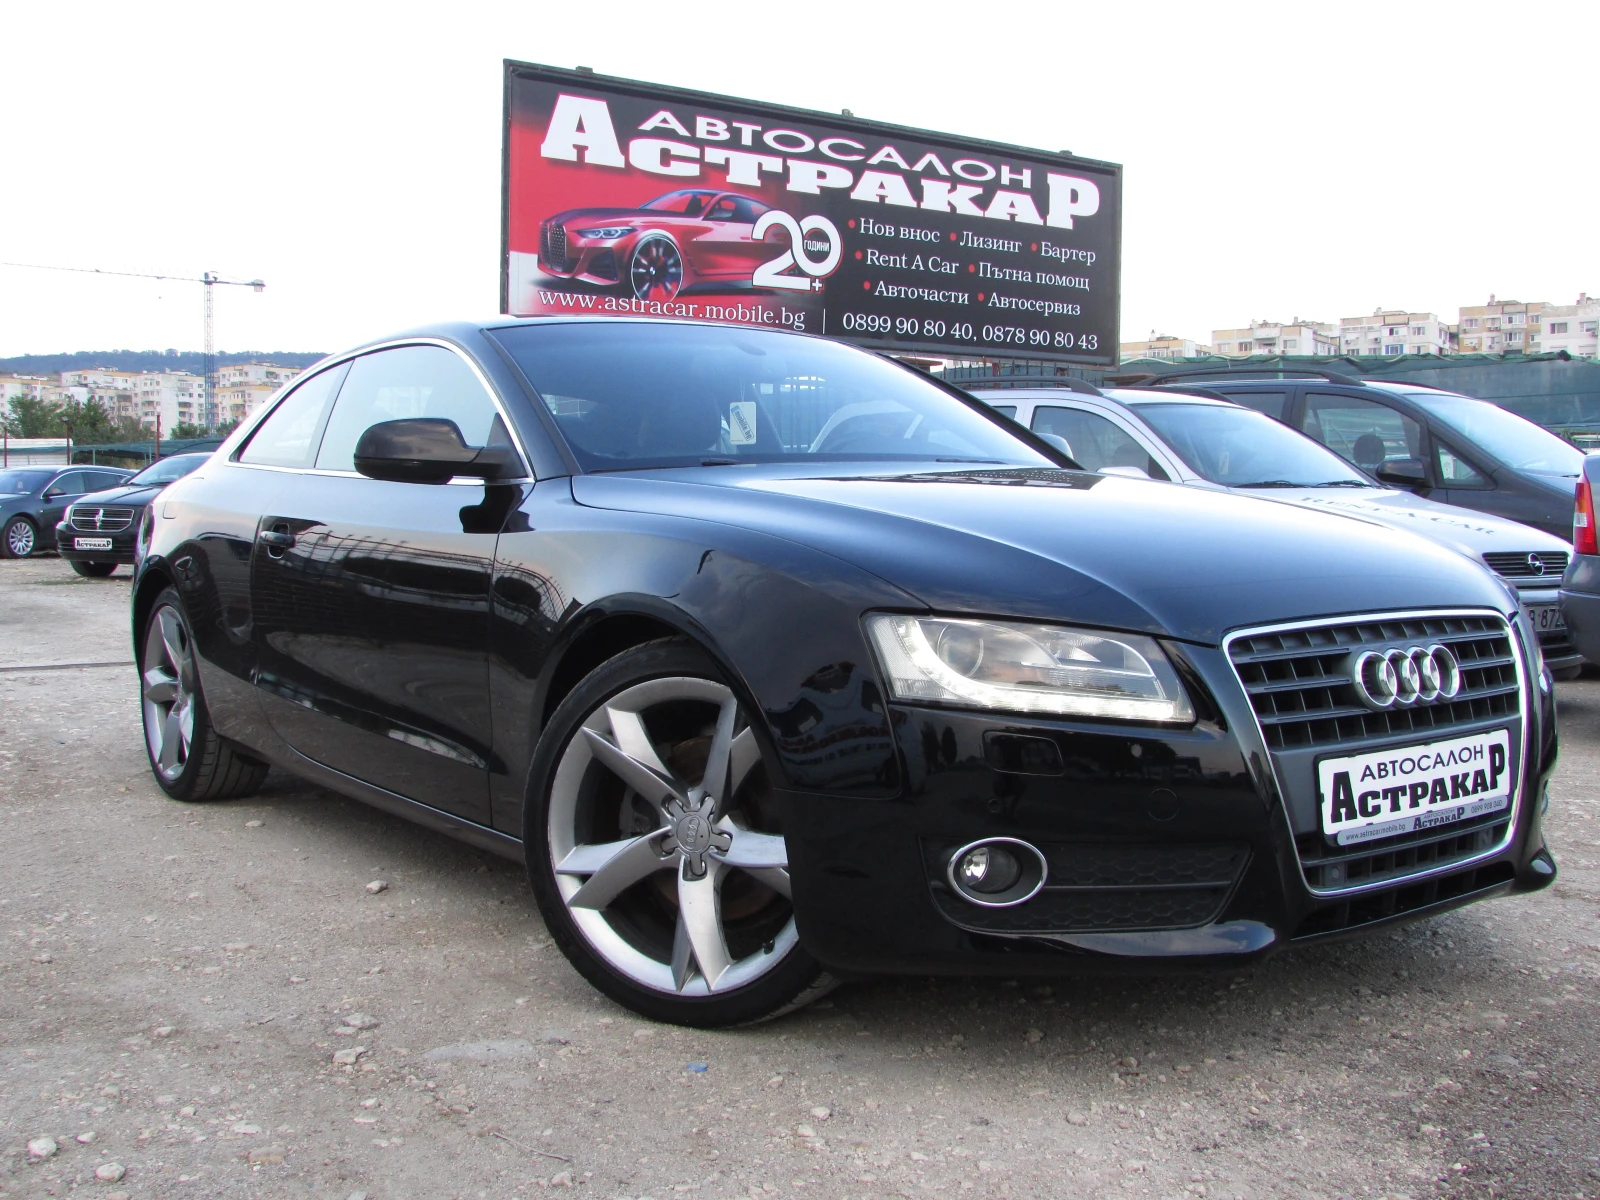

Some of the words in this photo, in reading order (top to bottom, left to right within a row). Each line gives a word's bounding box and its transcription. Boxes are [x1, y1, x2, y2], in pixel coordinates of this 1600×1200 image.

[637, 110, 1032, 188] АВТОСАЛОН
[860, 218, 895, 237] Нов
[900, 226, 940, 243] внос
[960, 232, 1022, 253] Лизинг
[866, 249, 908, 269] Rent
[911, 255, 925, 270] A
[928, 257, 959, 274] Car
[1041, 242, 1096, 266] Бартер
[979, 263, 1032, 283] Пътна
[1036, 273, 1089, 291] помощ
[874, 281, 969, 305] Авточасти
[988, 293, 1081, 316] Автосервиз
[538, 290, 806, 330] www.astracar.mobile.bg
[843, 313, 891, 333] 0899
[896, 318, 919, 335] 90
[923, 320, 946, 337] 80
[950, 323, 977, 341] 40,
[982, 325, 1025, 344] 0878
[1029, 329, 1050, 346] 90
[1054, 331, 1074, 349] 80
[1078, 333, 1098, 350] 43
[1360, 744, 1484, 782] АВТОСАЛОН
[1470, 804, 1483, 814] 0899
